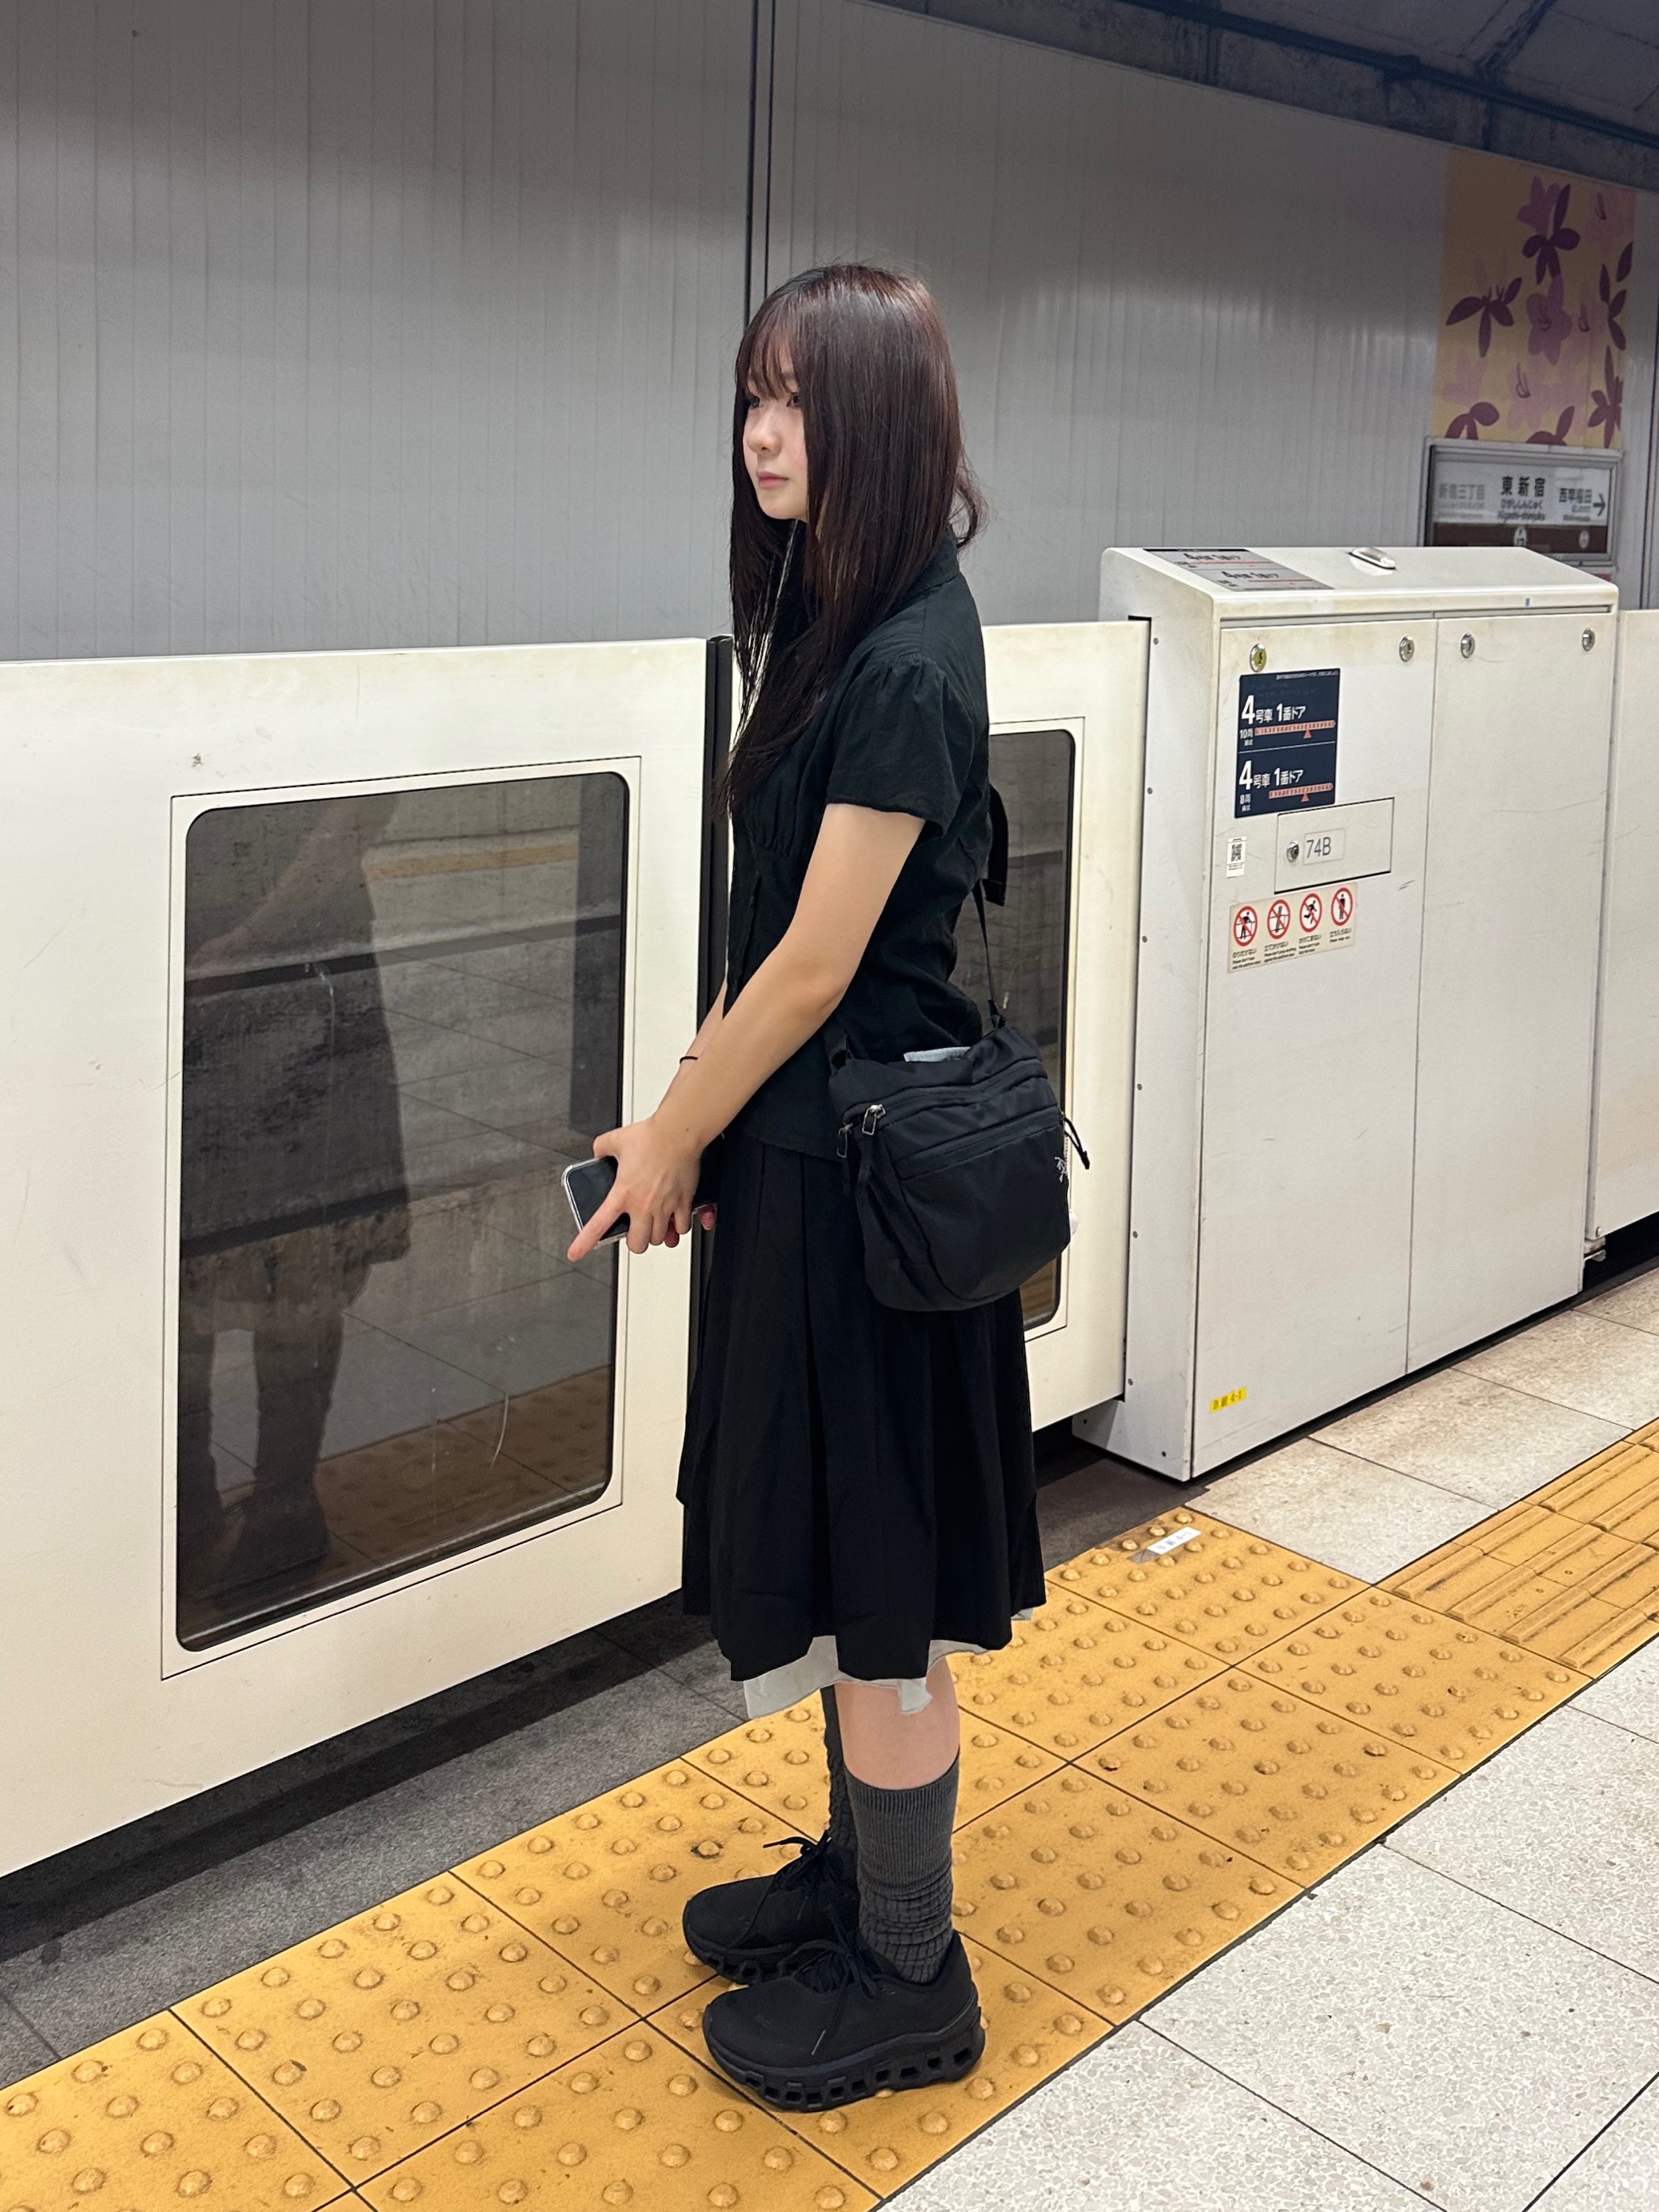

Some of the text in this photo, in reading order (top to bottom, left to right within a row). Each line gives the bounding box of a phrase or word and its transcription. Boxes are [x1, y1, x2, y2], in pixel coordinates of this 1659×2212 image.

[1501, 476, 1545, 497] 東新宿
[1241, 695, 1306, 724] 4号車 1番ドア
[1238, 759, 1304, 790] 4号車 1番ドア
[1306, 836, 1332, 859] 74B
